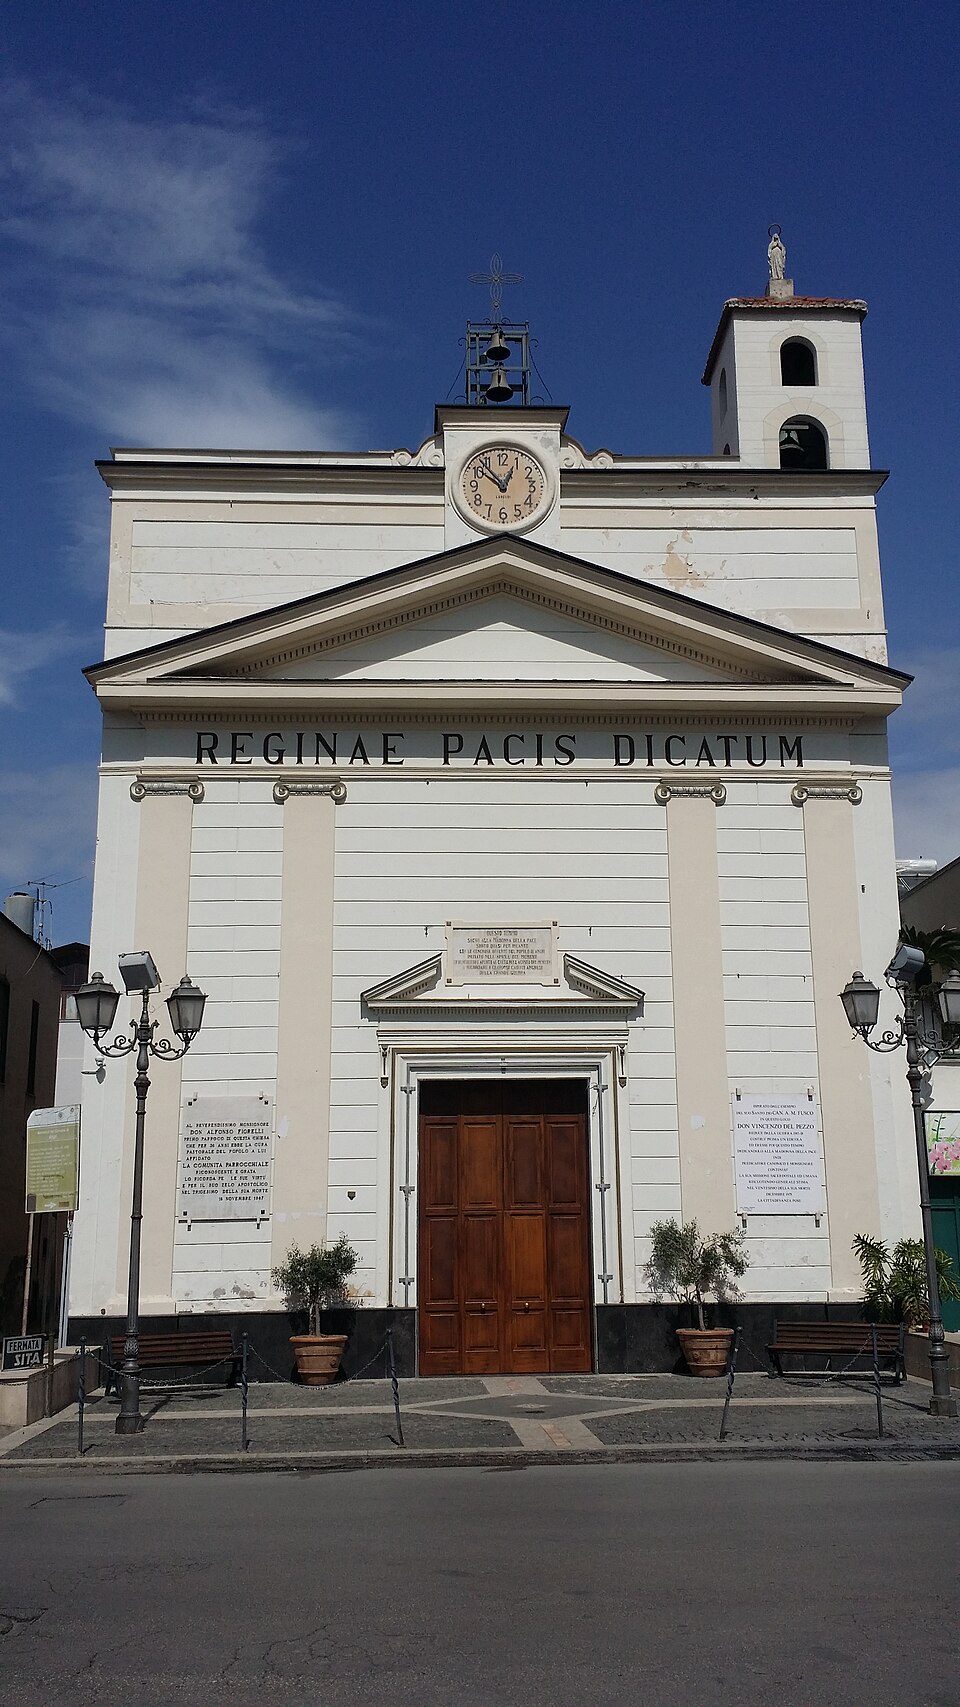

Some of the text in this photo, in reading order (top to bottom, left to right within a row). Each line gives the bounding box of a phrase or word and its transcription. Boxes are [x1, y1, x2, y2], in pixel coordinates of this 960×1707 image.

[497, 453, 508, 467] 12
[515, 457, 519, 470] 1
[473, 466, 484, 479] 10
[525, 467, 533, 480] 2
[470, 480, 478, 492] 9
[529, 480, 536, 493] 3
[474, 494, 482, 506] 8
[524, 494, 533, 508] 4
[485, 504, 493, 517] 7
[499, 507, 508, 520] 6
[514, 505, 522, 517] 5
[194, 732, 805, 768] REGINAE PACIS DICATUM
[9, 1340, 40, 1352] FERMATA
[14, 1352, 41, 1366] SITA
